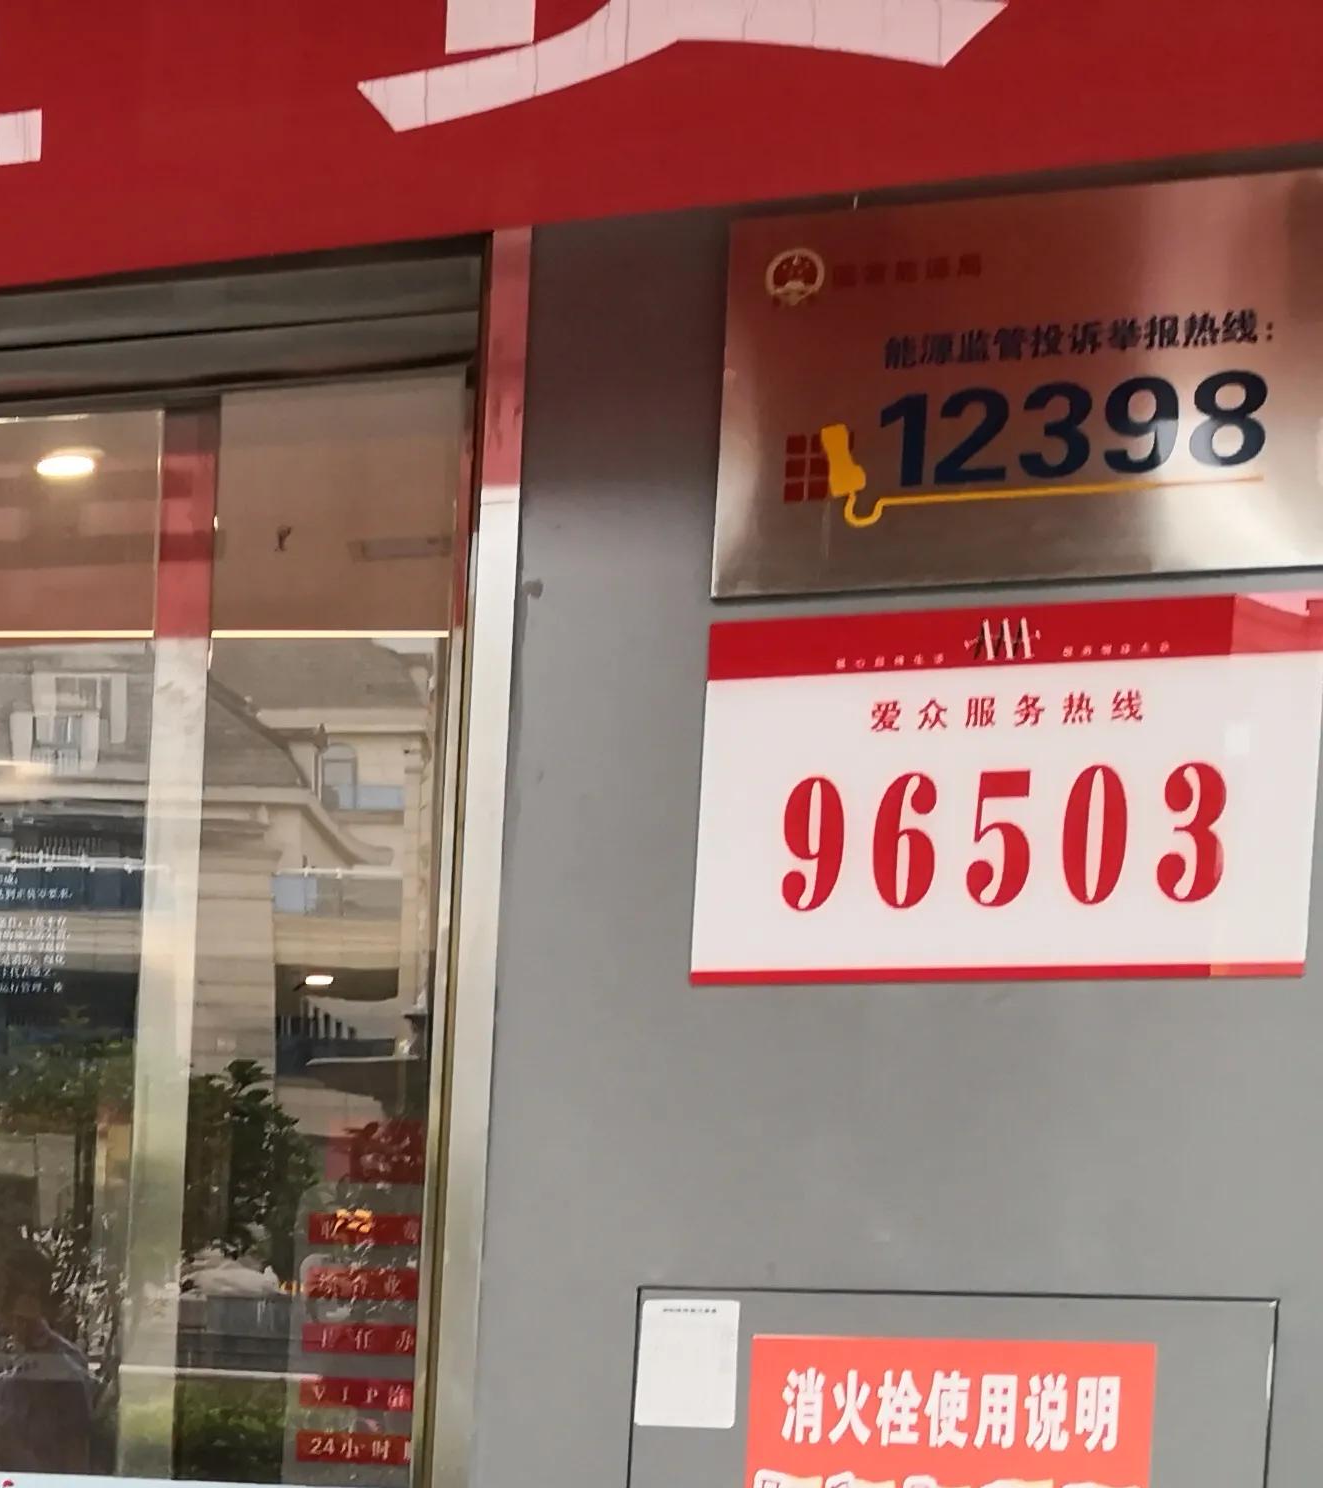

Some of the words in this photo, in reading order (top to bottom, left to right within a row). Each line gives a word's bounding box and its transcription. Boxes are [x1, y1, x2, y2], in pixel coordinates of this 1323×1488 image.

[879, 369, 1269, 488] 12398
[870, 689, 1144, 733] 爱众服务热线
[781, 762, 1228, 912] 96503
[781, 1366, 1123, 1452] 消火栓使用说明
